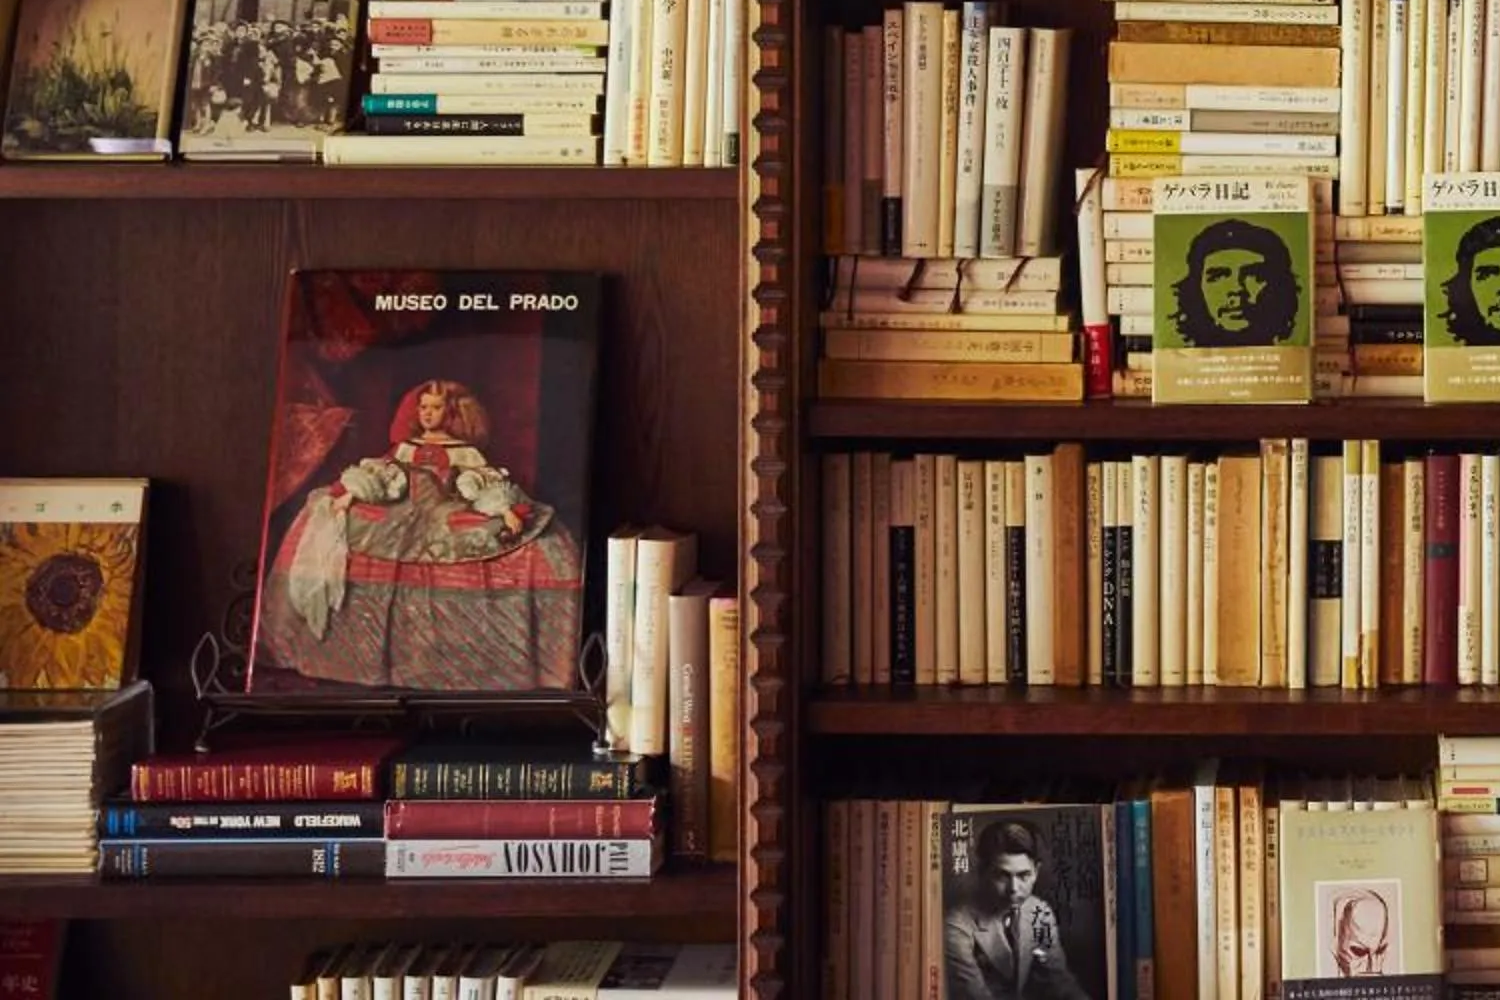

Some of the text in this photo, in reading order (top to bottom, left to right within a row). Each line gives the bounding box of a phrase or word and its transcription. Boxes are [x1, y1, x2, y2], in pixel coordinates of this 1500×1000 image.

[1163, 181, 1251, 201] ゲバラ日記
[375, 294, 579, 311] MUSEO DEL PRADO
[169, 815, 192, 828] 50s
[219, 815, 251, 827] YORK
[253, 815, 281, 827] NEW
[294, 814, 361, 827] WAKEFIELD
[312, 848, 325, 873] 1812
[503, 841, 605, 873] JOHNSON
[609, 841, 628, 873] PAUL
